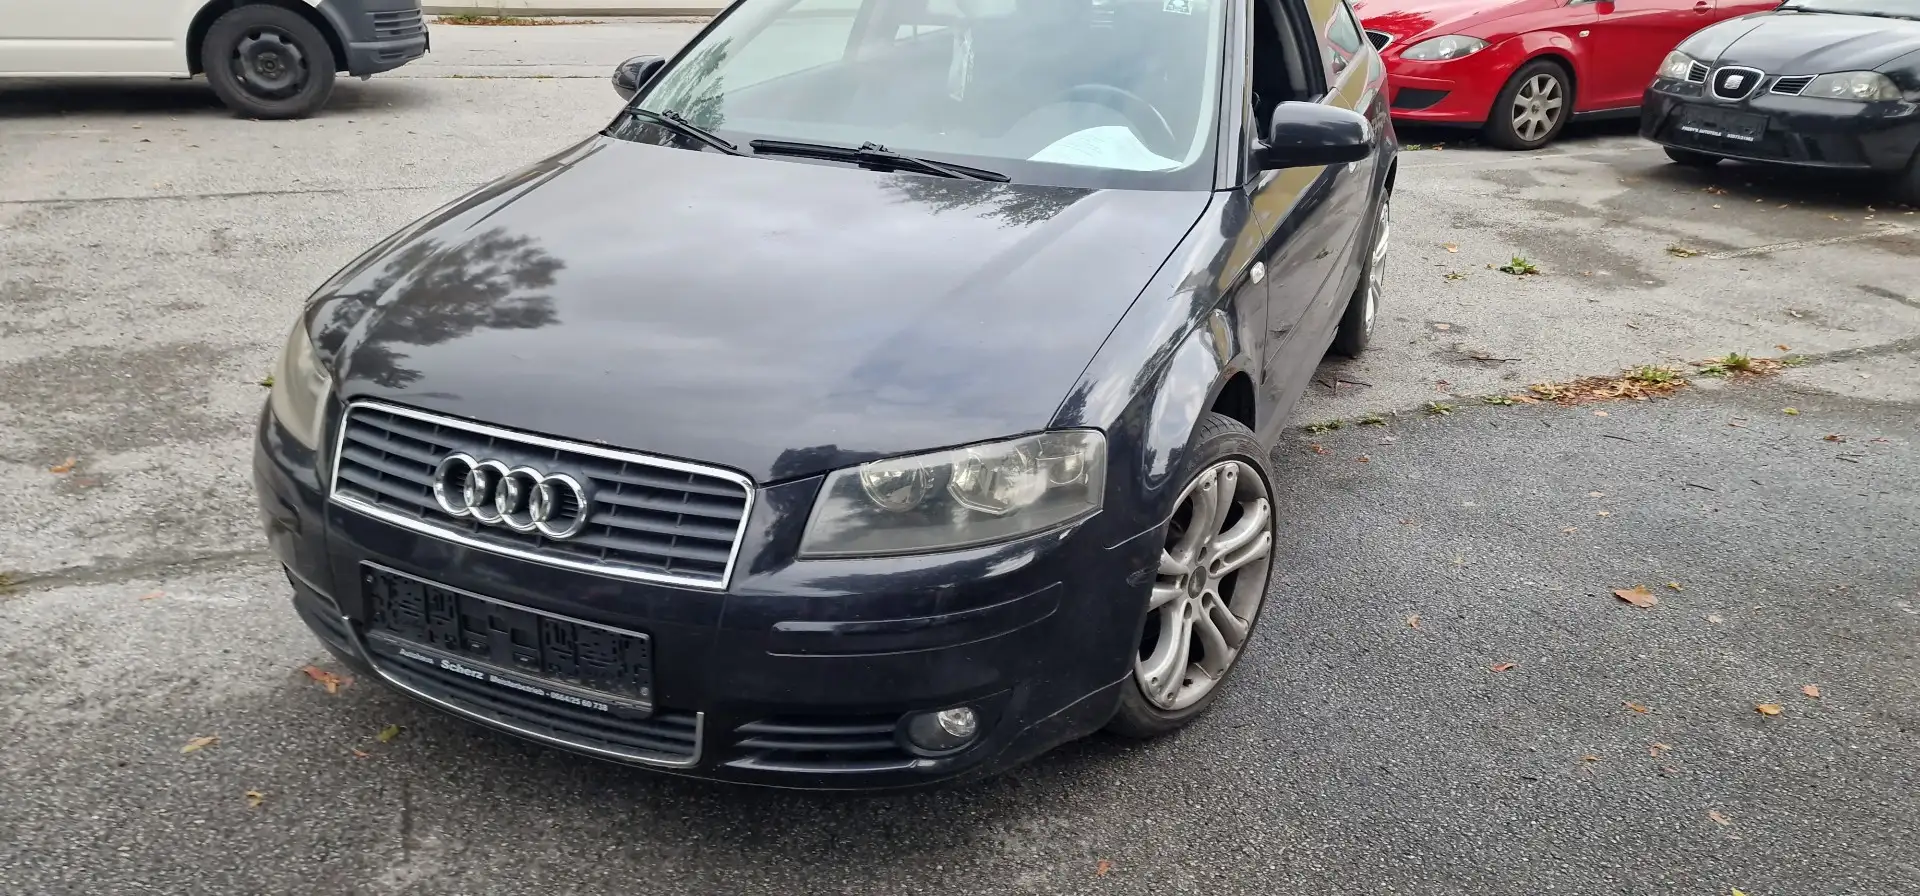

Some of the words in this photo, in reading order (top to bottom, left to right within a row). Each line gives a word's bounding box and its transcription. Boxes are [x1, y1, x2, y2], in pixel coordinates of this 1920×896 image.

[399, 648, 435, 664] Autohaus
[440, 659, 484, 680] Scherz
[490, 675, 545, 696] Meisterbetrieb
